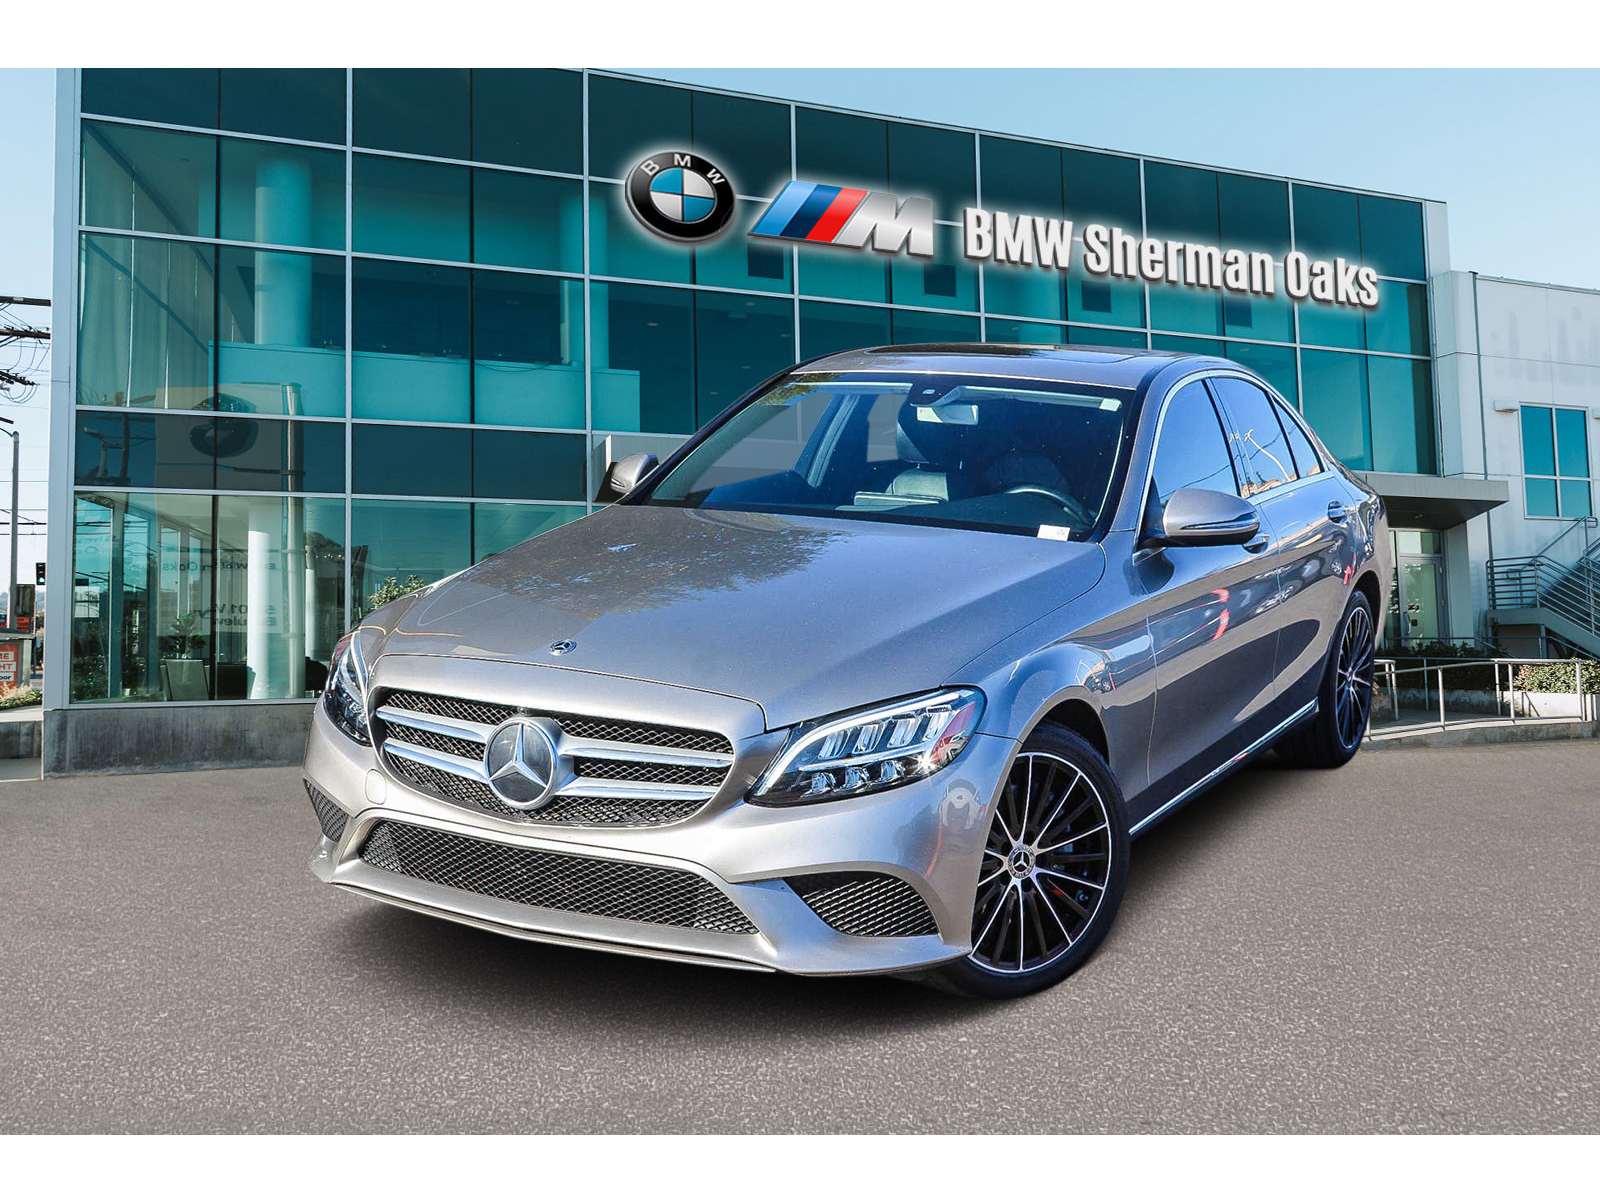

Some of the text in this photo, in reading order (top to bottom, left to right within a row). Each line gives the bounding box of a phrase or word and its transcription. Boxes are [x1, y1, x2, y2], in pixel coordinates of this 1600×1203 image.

[640, 153, 726, 186] BMW
[963, 206, 1381, 309] BMW Sherman Oaks
